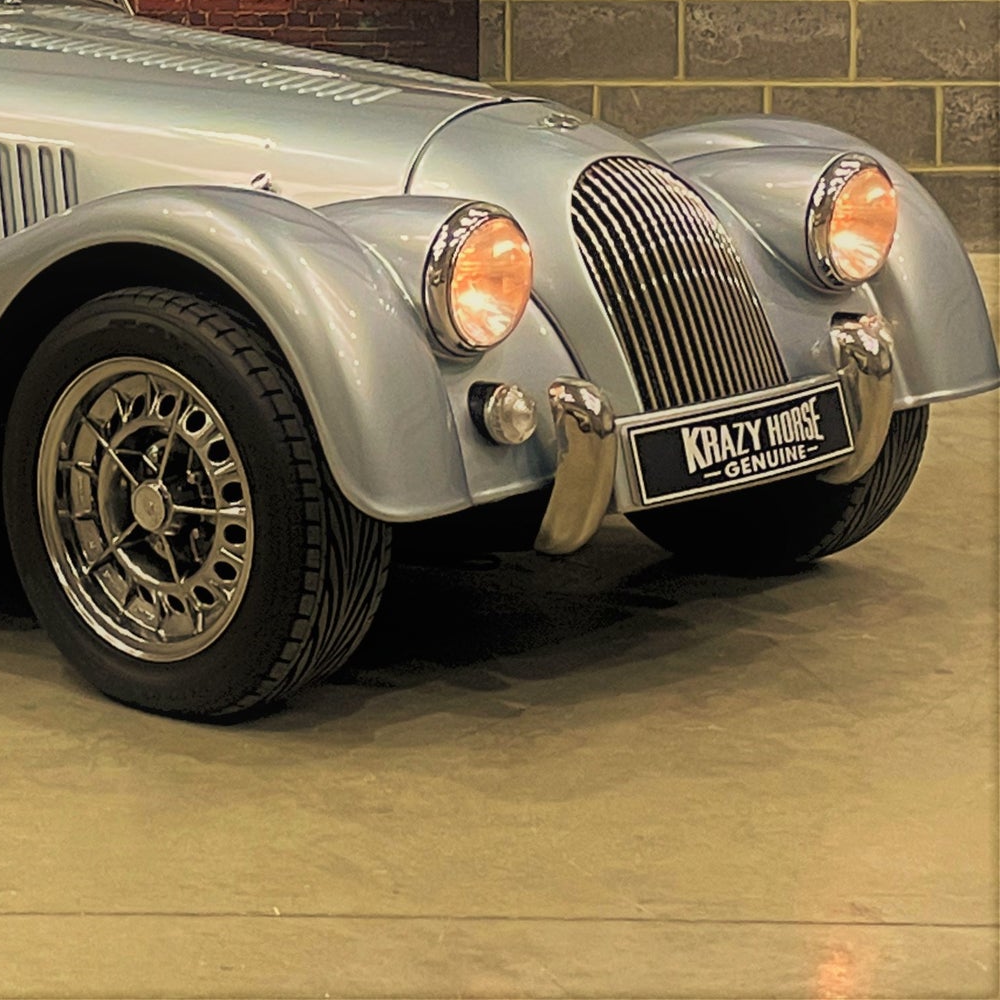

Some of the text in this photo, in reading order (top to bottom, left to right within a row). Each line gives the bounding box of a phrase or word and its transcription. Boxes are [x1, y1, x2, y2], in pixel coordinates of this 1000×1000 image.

[681, 397, 824, 474] KRAZY HORSE
[725, 445, 807, 478] GENUINE
